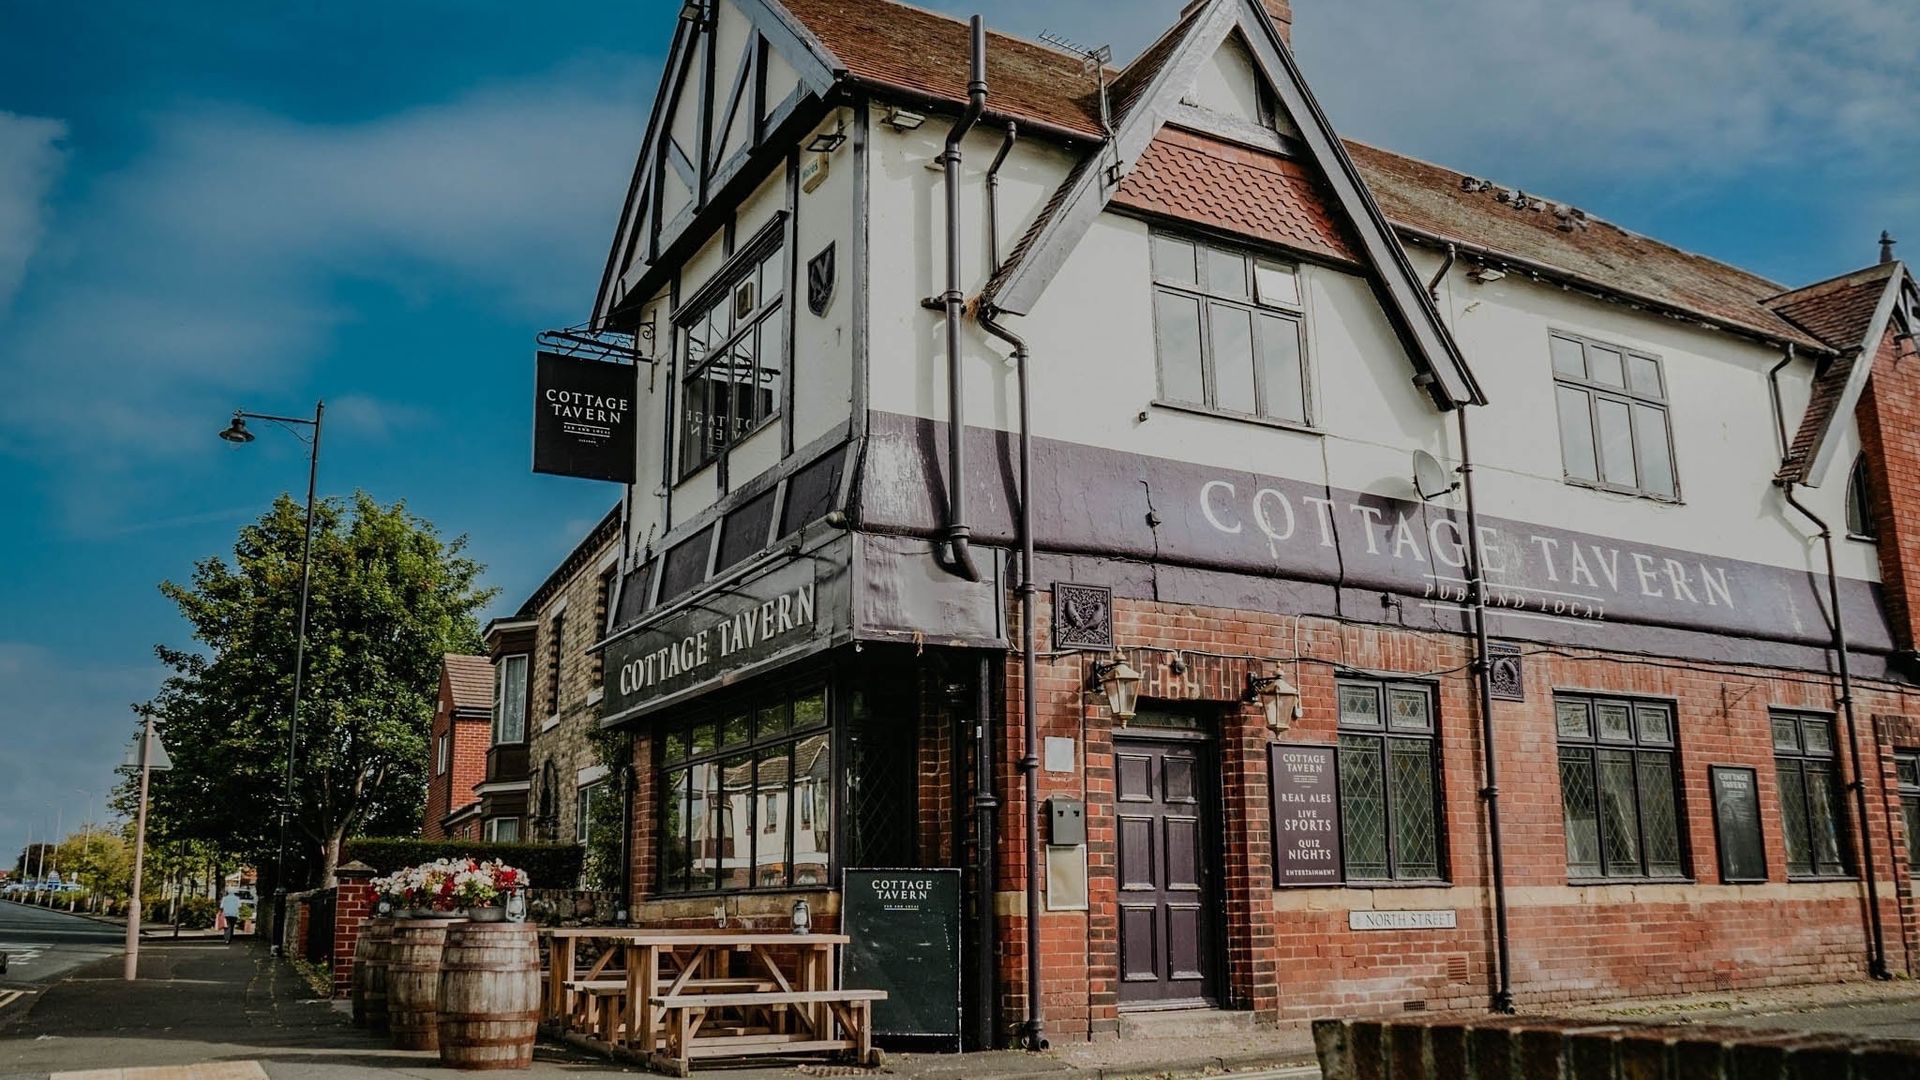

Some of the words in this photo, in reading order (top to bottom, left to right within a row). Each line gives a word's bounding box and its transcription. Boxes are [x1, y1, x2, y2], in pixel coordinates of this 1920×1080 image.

[546, 389, 628, 411] COTTAGE
[552, 403, 621, 424] TAVERN
[1199, 480, 1505, 574] COTTAGE
[1531, 535, 1735, 609] TAVERN
[1424, 583, 1466, 602] PUB
[1482, 592, 1526, 609] AND
[1541, 597, 1605, 620] LOCAL
[620, 630, 709, 696] COTTAGE
[718, 583, 815, 657] TAVERN
[1282, 753, 1326, 764] COTTAGE
[1286, 763, 1323, 773] TAVERN
[1281, 793, 1306, 803] REAL
[1309, 793, 1332, 803] ALES
[1297, 810, 1317, 818] LIVE
[1284, 819, 1332, 832] SPORTS
[1298, 839, 1321, 849] QUIZ
[1288, 849, 1332, 860] NIGHTS
[1285, 868, 1336, 876] ENTERTAINMENT
[872, 879, 933, 890] COTTAGE
[876, 890, 927, 900] TAVERN
[1366, 912, 1406, 927] NORTH
[1411, 912, 1451, 927] STREET
